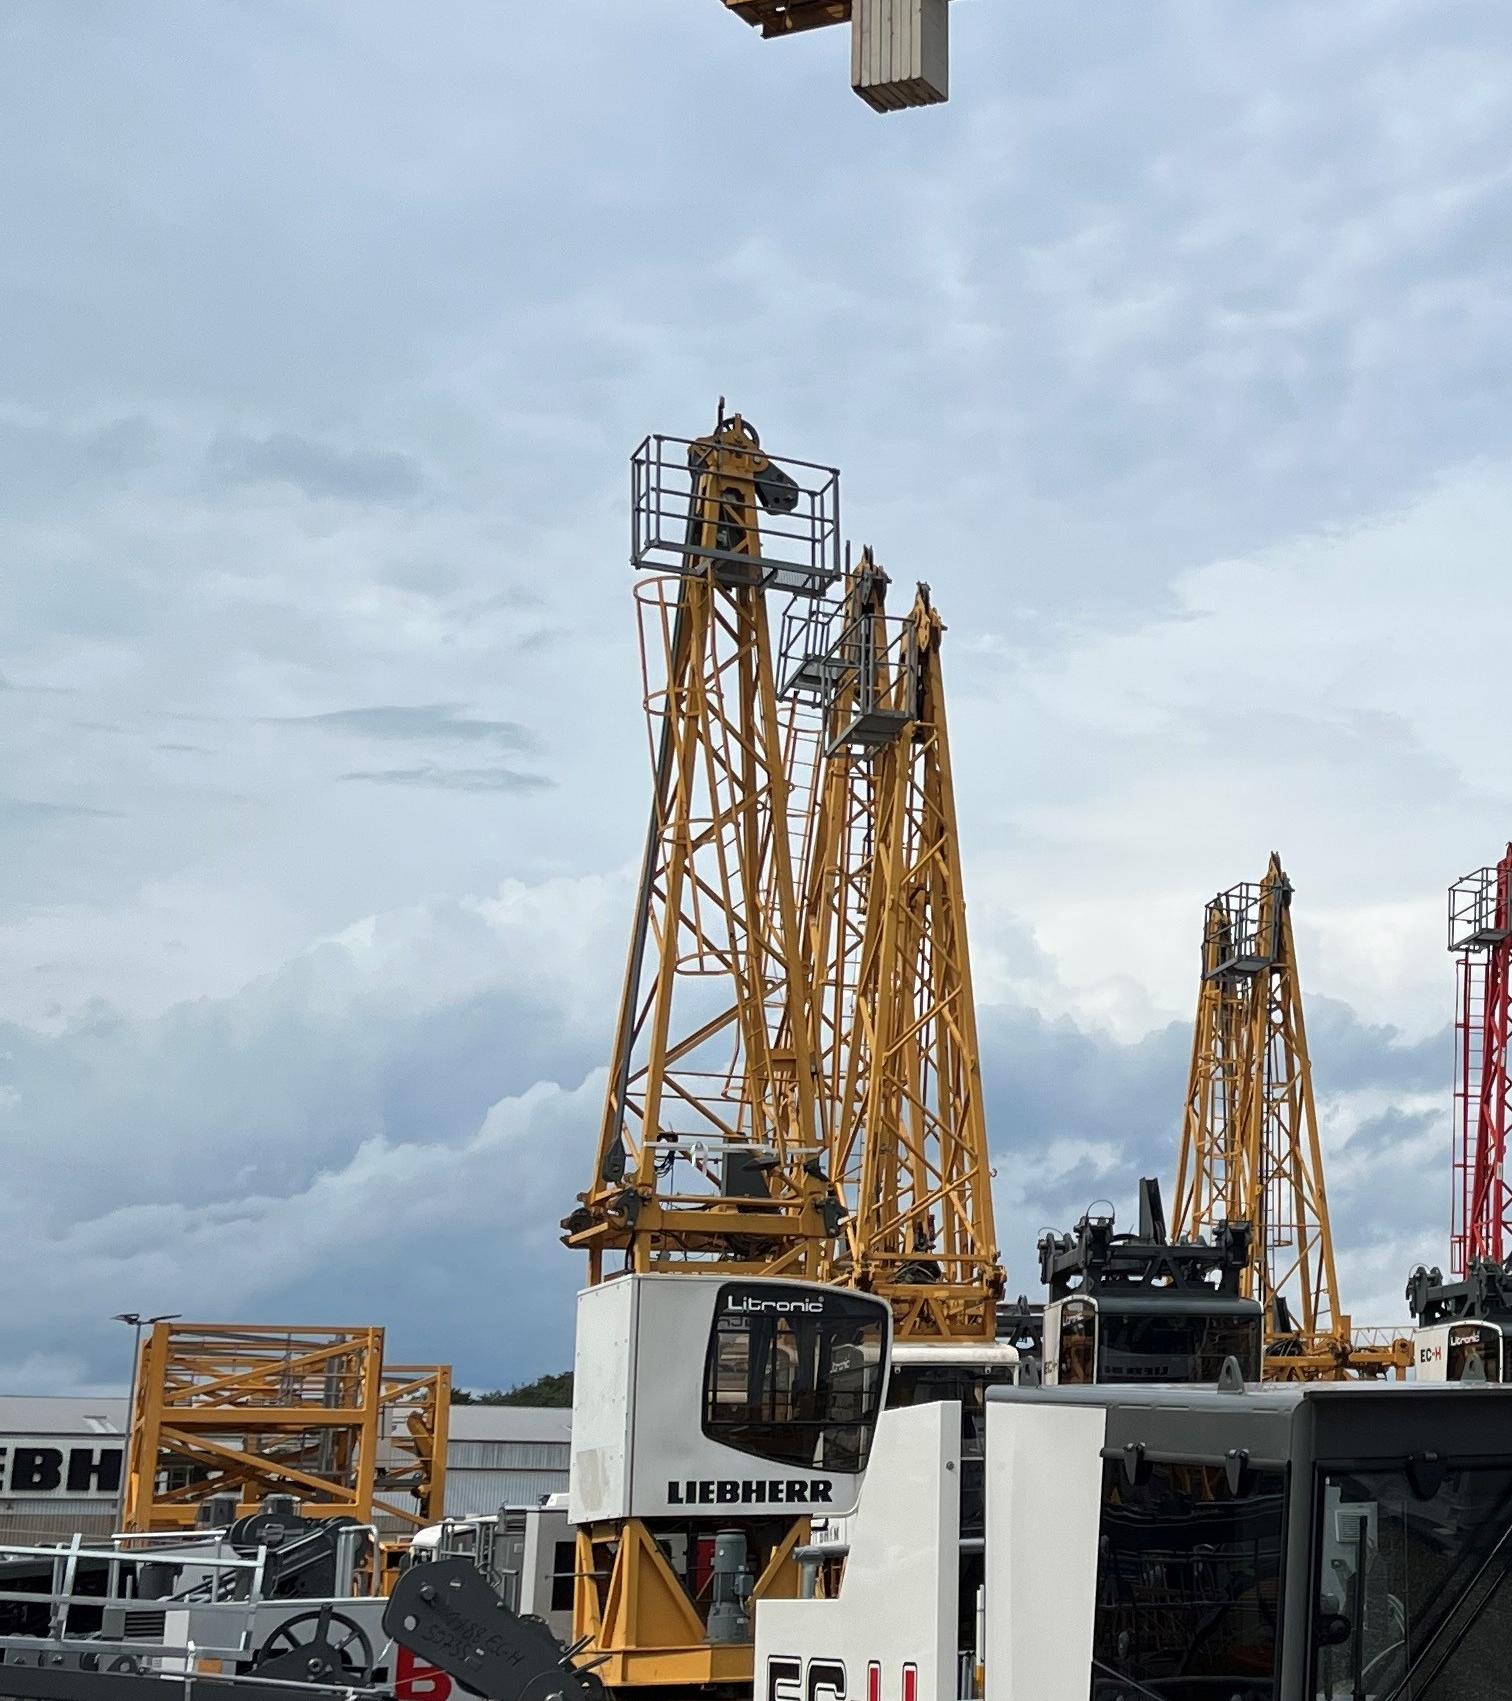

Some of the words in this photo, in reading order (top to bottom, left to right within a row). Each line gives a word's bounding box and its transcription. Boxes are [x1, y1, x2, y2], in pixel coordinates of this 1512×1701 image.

[728, 1295, 824, 1313] Litronic
[1420, 1346, 1442, 1363] EC-H
[0, 1447, 123, 1491] BH
[667, 1480, 833, 1505] LIEBHERR
